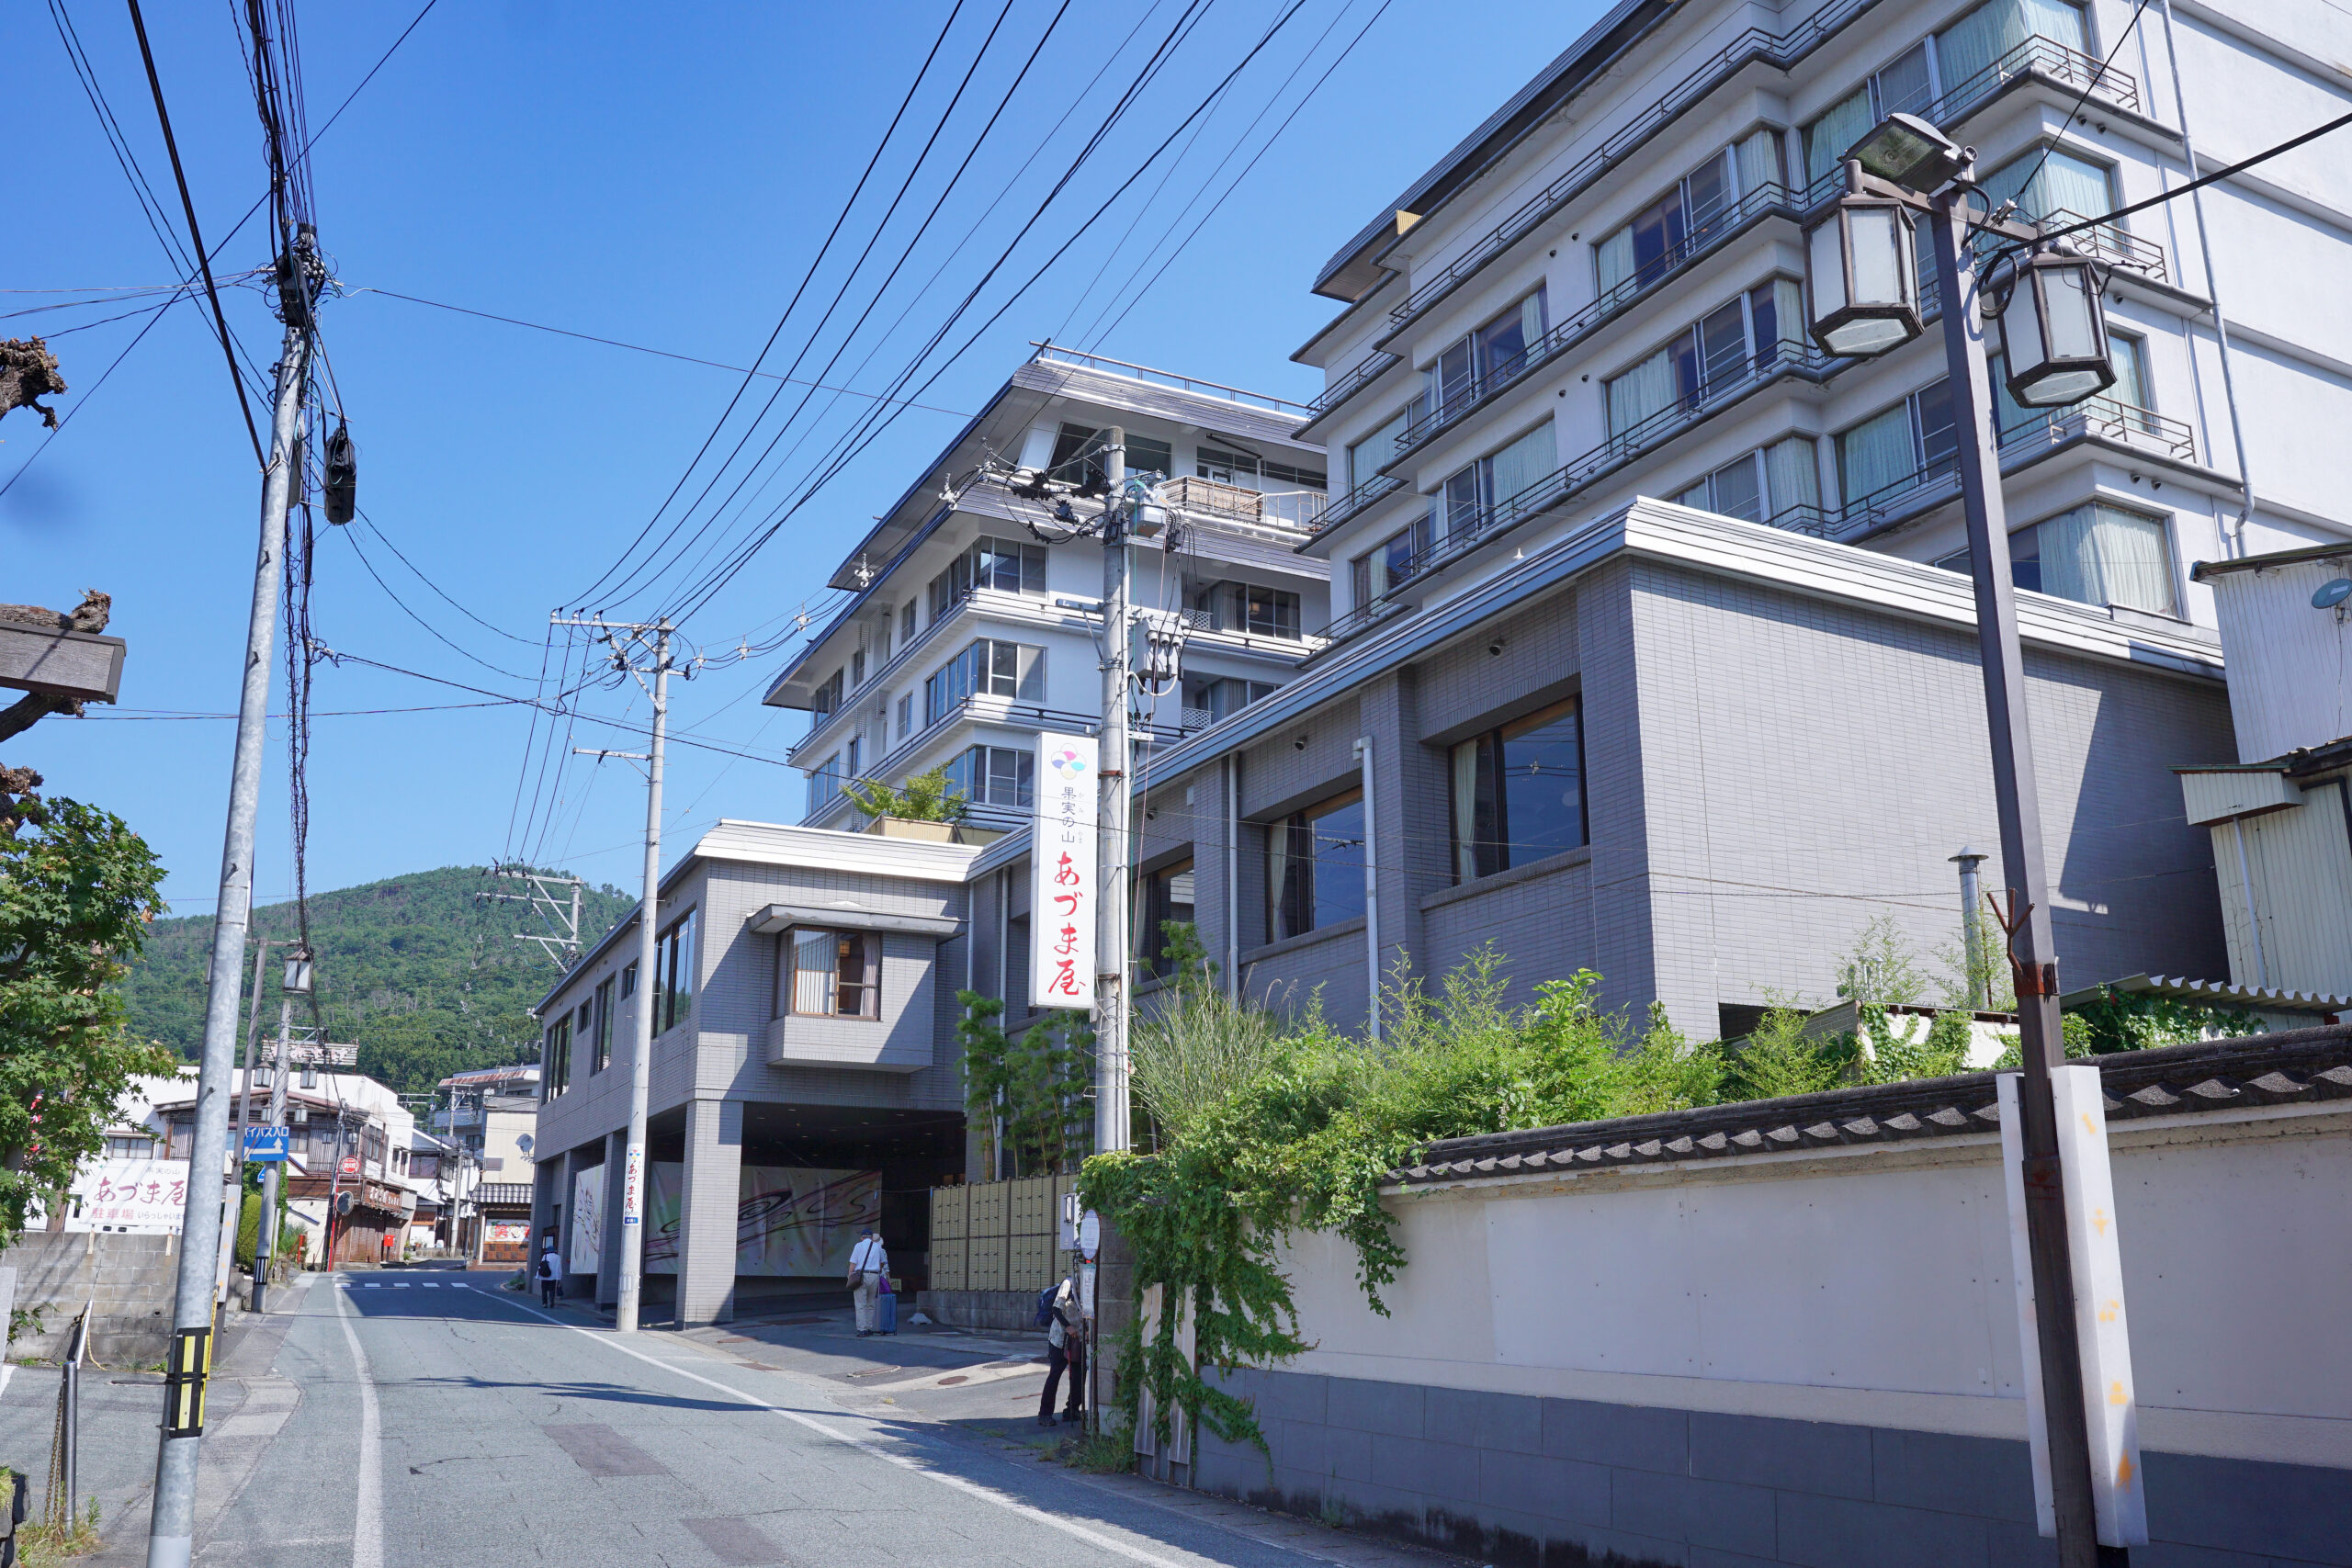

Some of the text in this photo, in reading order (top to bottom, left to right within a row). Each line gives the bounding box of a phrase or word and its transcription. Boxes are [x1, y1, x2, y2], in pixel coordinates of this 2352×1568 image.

[1061, 786, 1077, 843] 果実の山
[1047, 850, 1087, 997] あづま屋
[93, 1175, 187, 1206] あづま屋
[625, 1162, 638, 1213] あづま屋
[92, 1207, 134, 1221] 駐車場
[137, 1211, 186, 1221] いらっしゃいま
